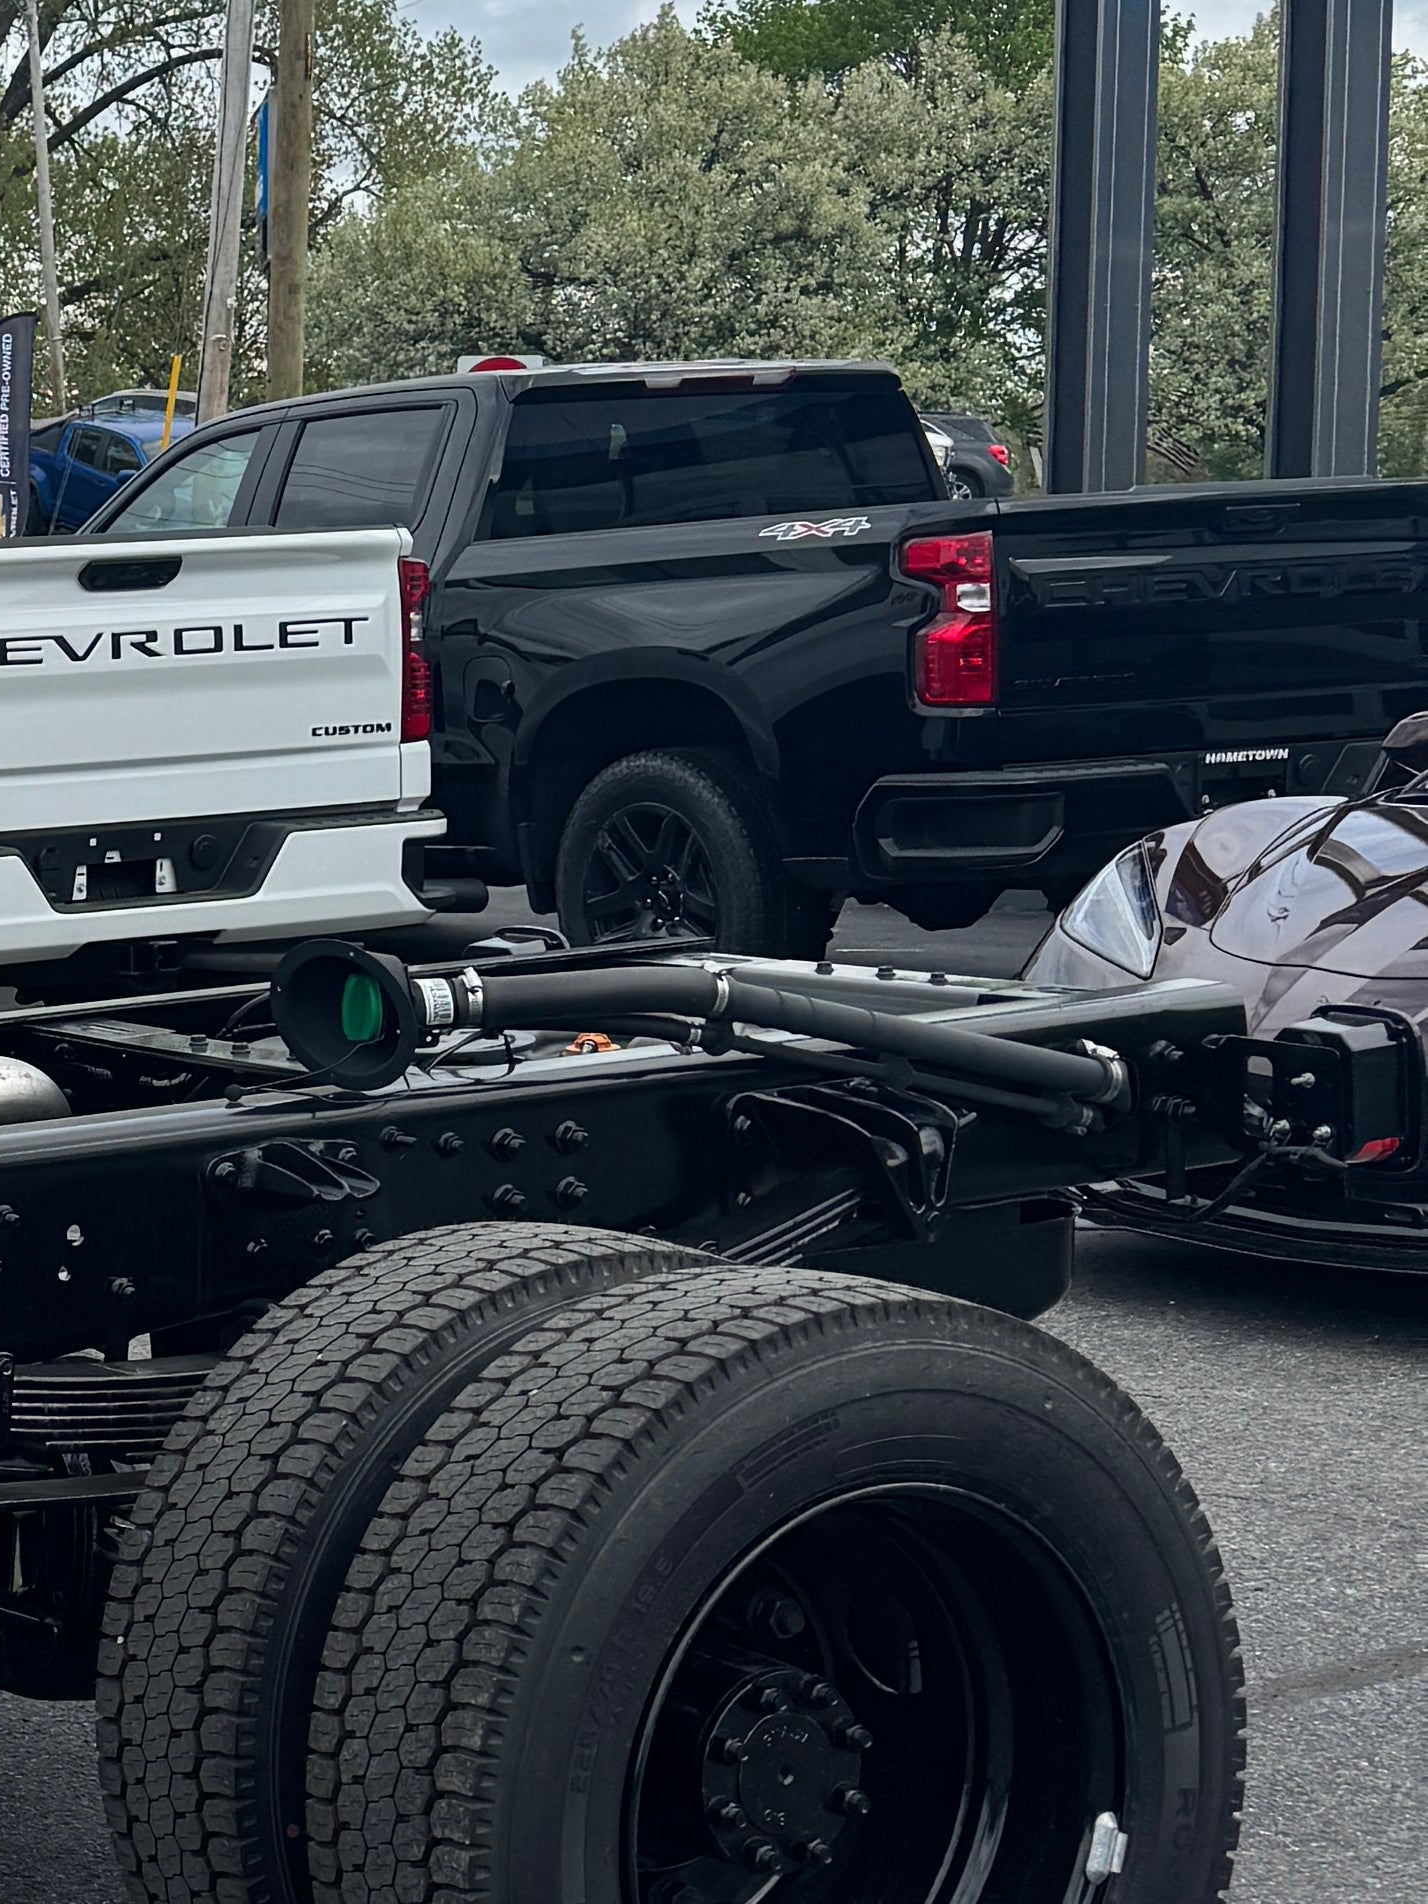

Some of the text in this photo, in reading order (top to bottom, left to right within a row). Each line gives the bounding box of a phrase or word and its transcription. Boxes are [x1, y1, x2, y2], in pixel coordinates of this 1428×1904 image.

[0, 332, 13, 412] PRE-OWNED
[311, 722, 392, 737] CUSTOM
[1204, 748, 1290, 764] HOMETOWN
